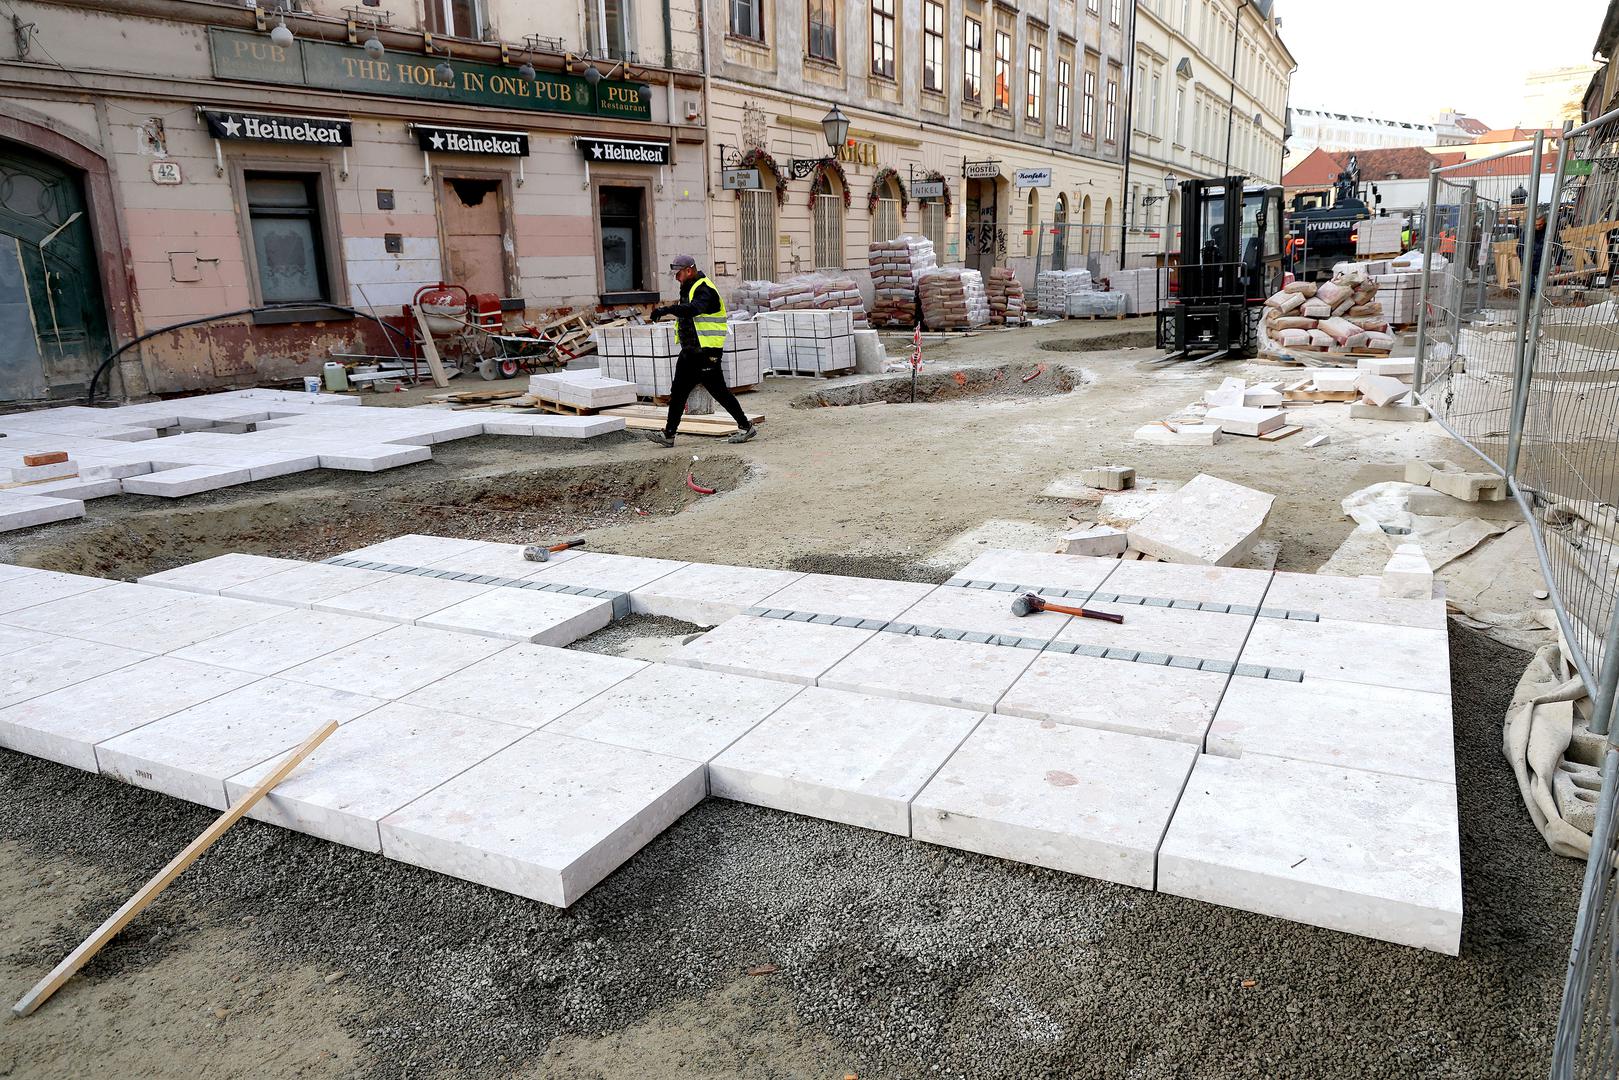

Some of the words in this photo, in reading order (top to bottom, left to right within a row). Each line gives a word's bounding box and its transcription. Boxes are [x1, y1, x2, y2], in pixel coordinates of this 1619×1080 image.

[232, 40, 287, 64] PUB
[341, 57, 391, 81] THE
[462, 71, 485, 92] IN
[489, 75, 530, 97] ONE
[534, 80, 572, 101] PUB
[608, 86, 639, 103] PUB
[601, 100, 647, 112] Restaurant
[243, 117, 342, 143] Heineken
[446, 133, 520, 154] Heineken
[604, 144, 663, 162] Heineken
[158, 164, 175, 177] 42
[970, 165, 997, 174] HOSTEL
[1307, 221, 1351, 231] HYUNDAI
